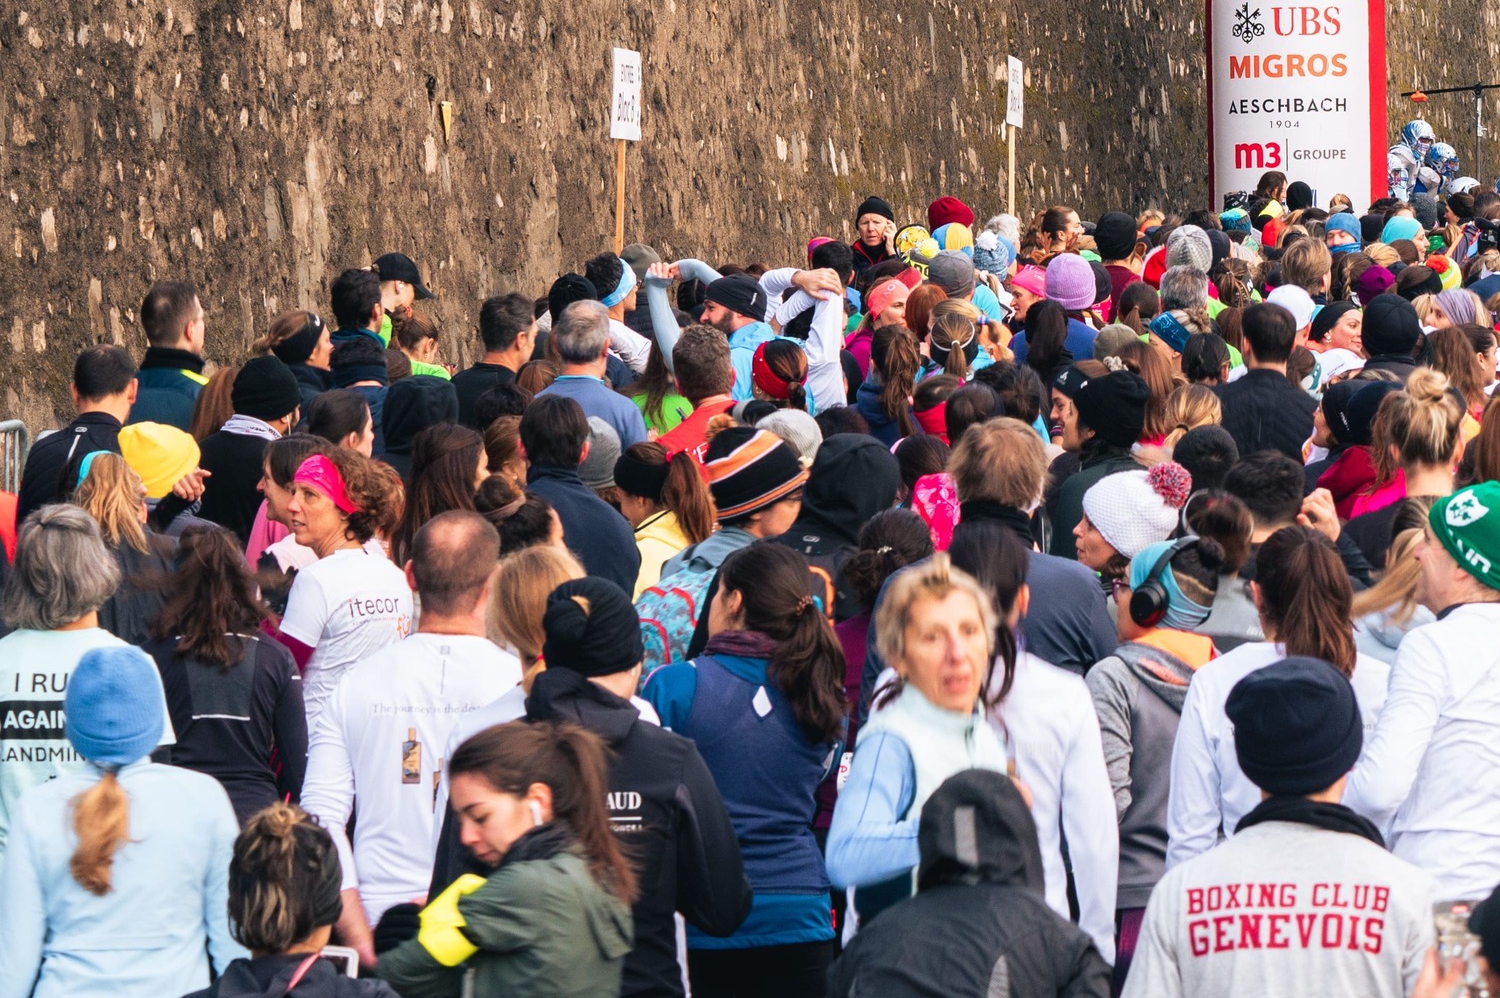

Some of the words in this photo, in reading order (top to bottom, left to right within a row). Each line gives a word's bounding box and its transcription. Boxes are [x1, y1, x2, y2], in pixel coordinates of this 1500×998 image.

[1271, 6, 1341, 36] UBS
[1229, 53, 1348, 79] MIGROS
[1229, 97, 1347, 115] AESCHBACH
[1269, 120, 1300, 129] 1904
[1235, 142, 1281, 169] m3
[1293, 149, 1346, 160] GROUPE
[348, 598, 399, 618] itecor
[1, 747, 87, 762] ANDMIN
[1187, 884, 1296, 915] BOXING
[1312, 883, 1390, 913] CLUB
[1188, 914, 1384, 957] GENEVOIS
